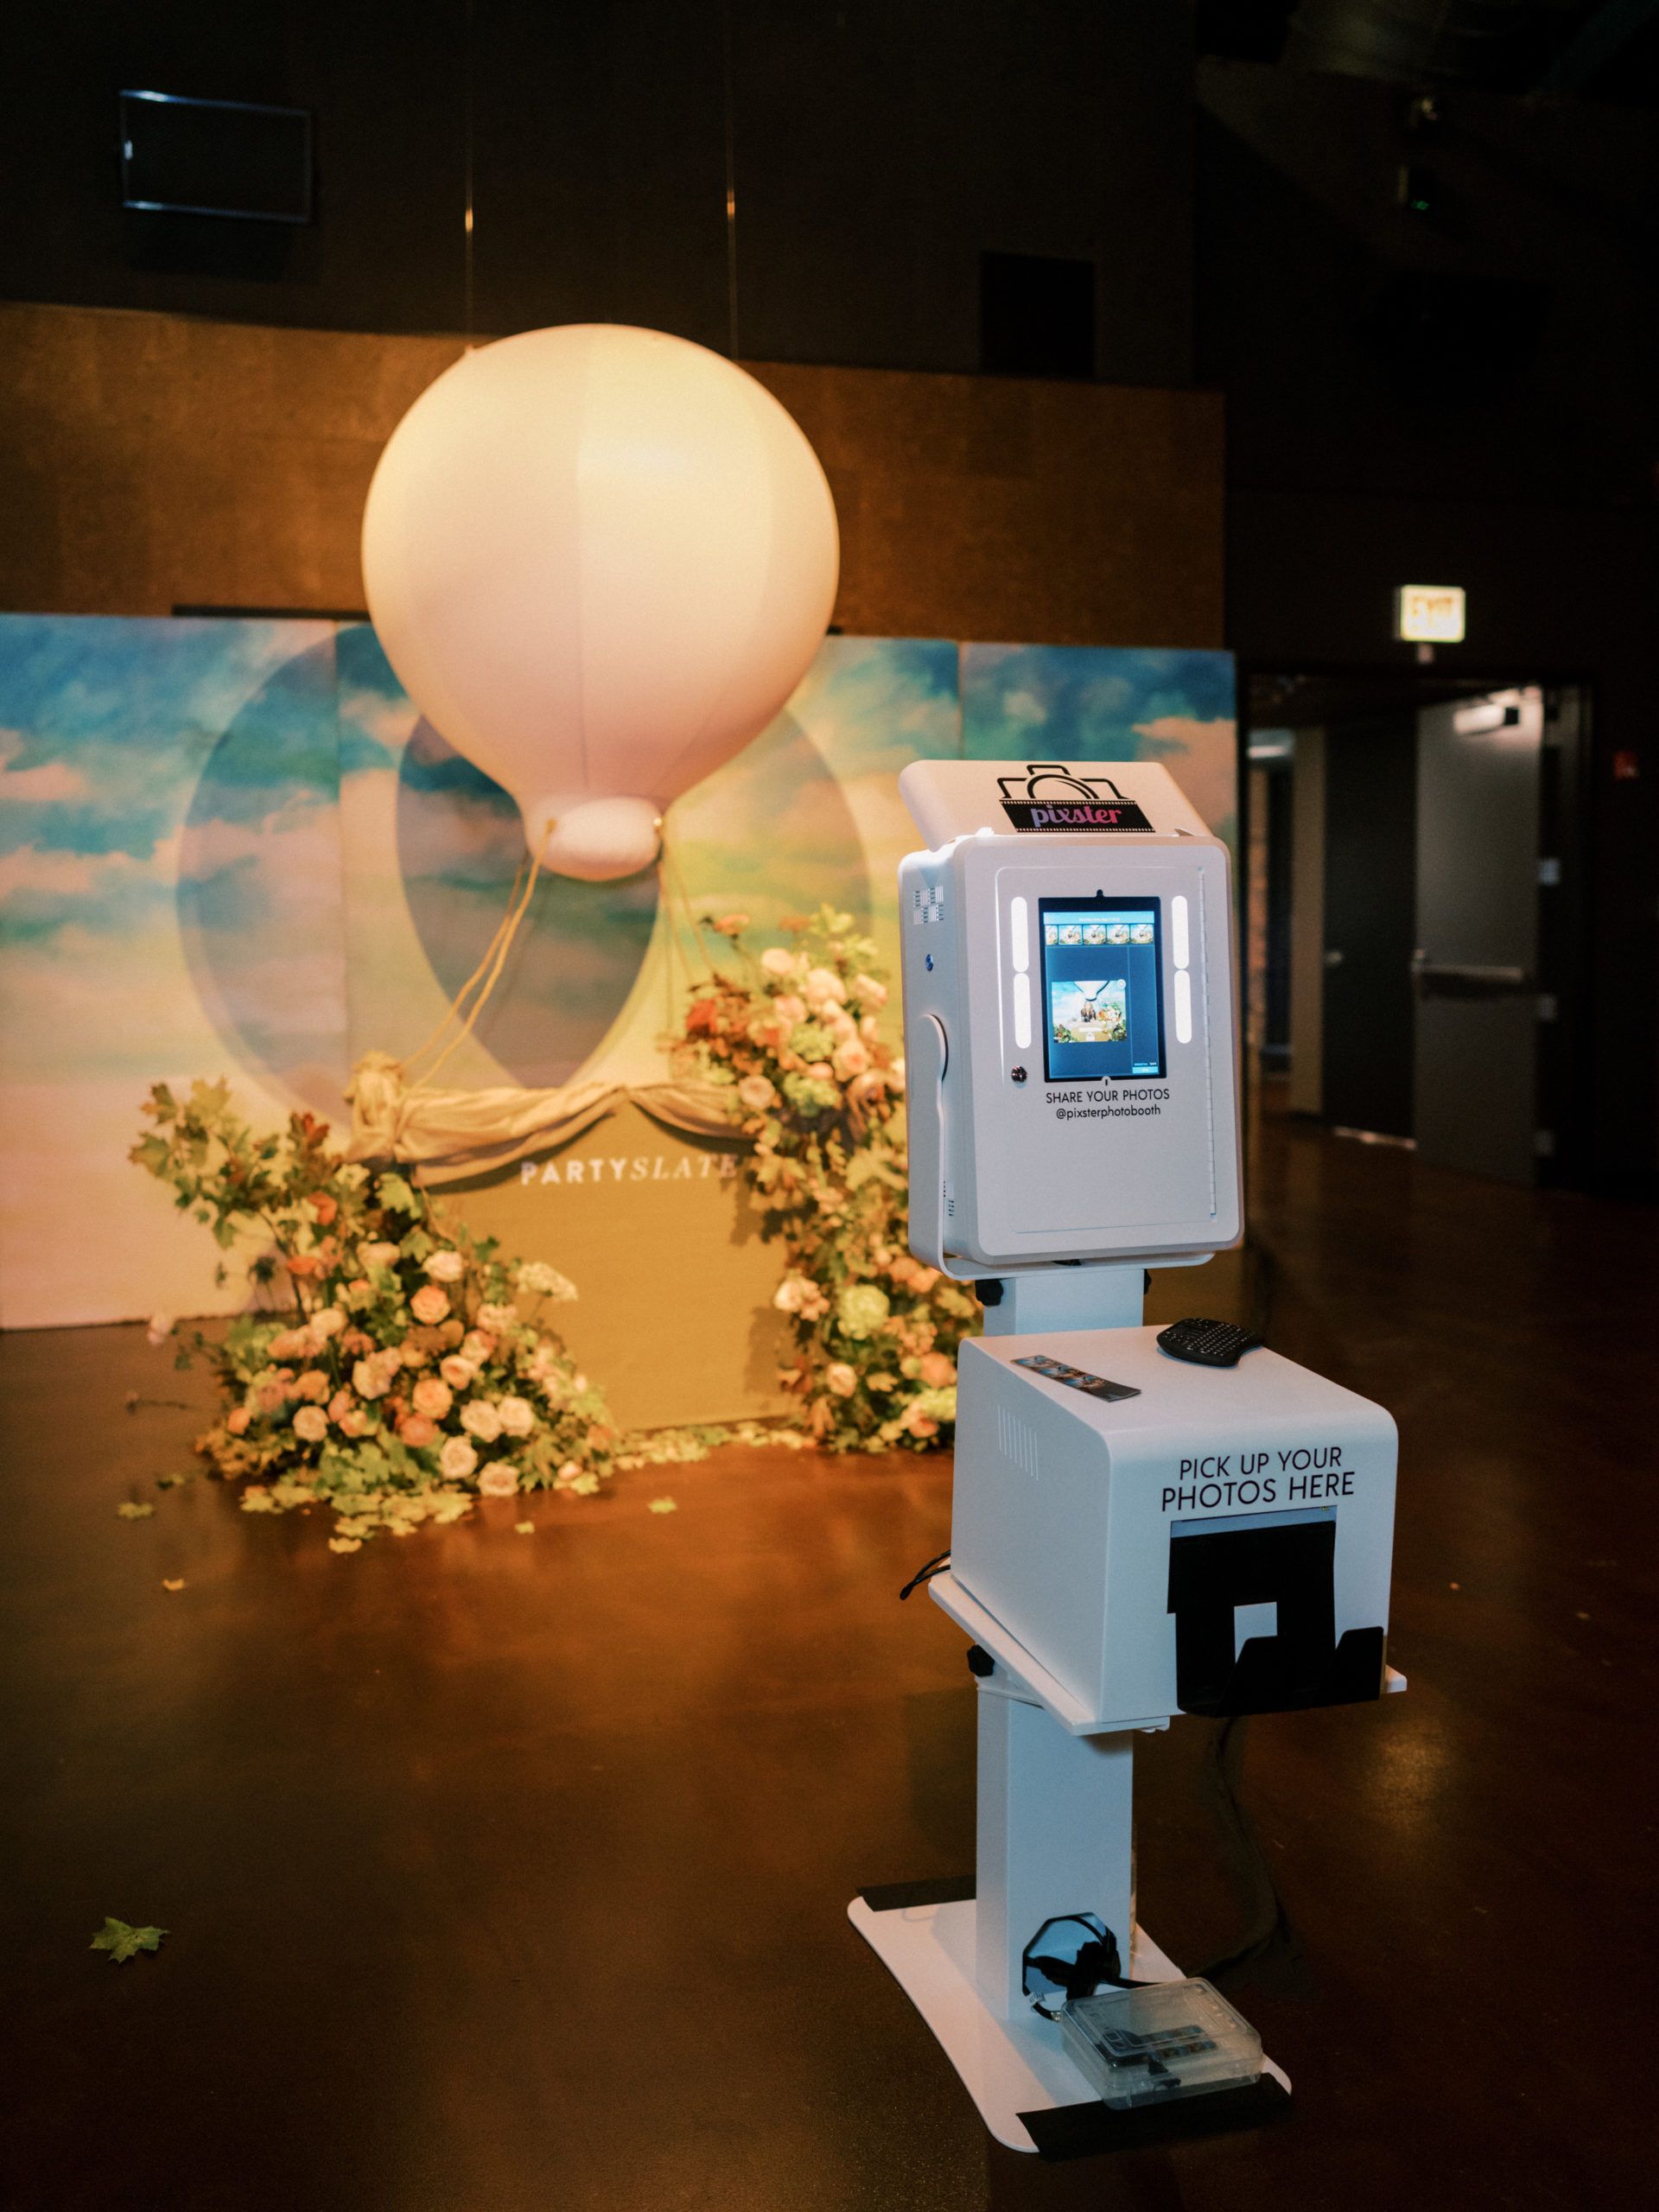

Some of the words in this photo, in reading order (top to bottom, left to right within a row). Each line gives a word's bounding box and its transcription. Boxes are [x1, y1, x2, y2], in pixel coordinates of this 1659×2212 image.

[1030, 804, 1122, 828] pixster
[1046, 1091, 1083, 1103] SHARE
[1087, 1090, 1118, 1102] YOUR
[1123, 1089, 1170, 1101] PHOTOS
[1056, 1103, 1161, 1121] @pixsterphotobooth
[1179, 1455, 1230, 1480] PICK
[1240, 1452, 1269, 1475] UP
[1278, 1446, 1342, 1471] YOUR
[1162, 1478, 1276, 1512] PHOTOS
[1288, 1471, 1355, 1500] HERE
